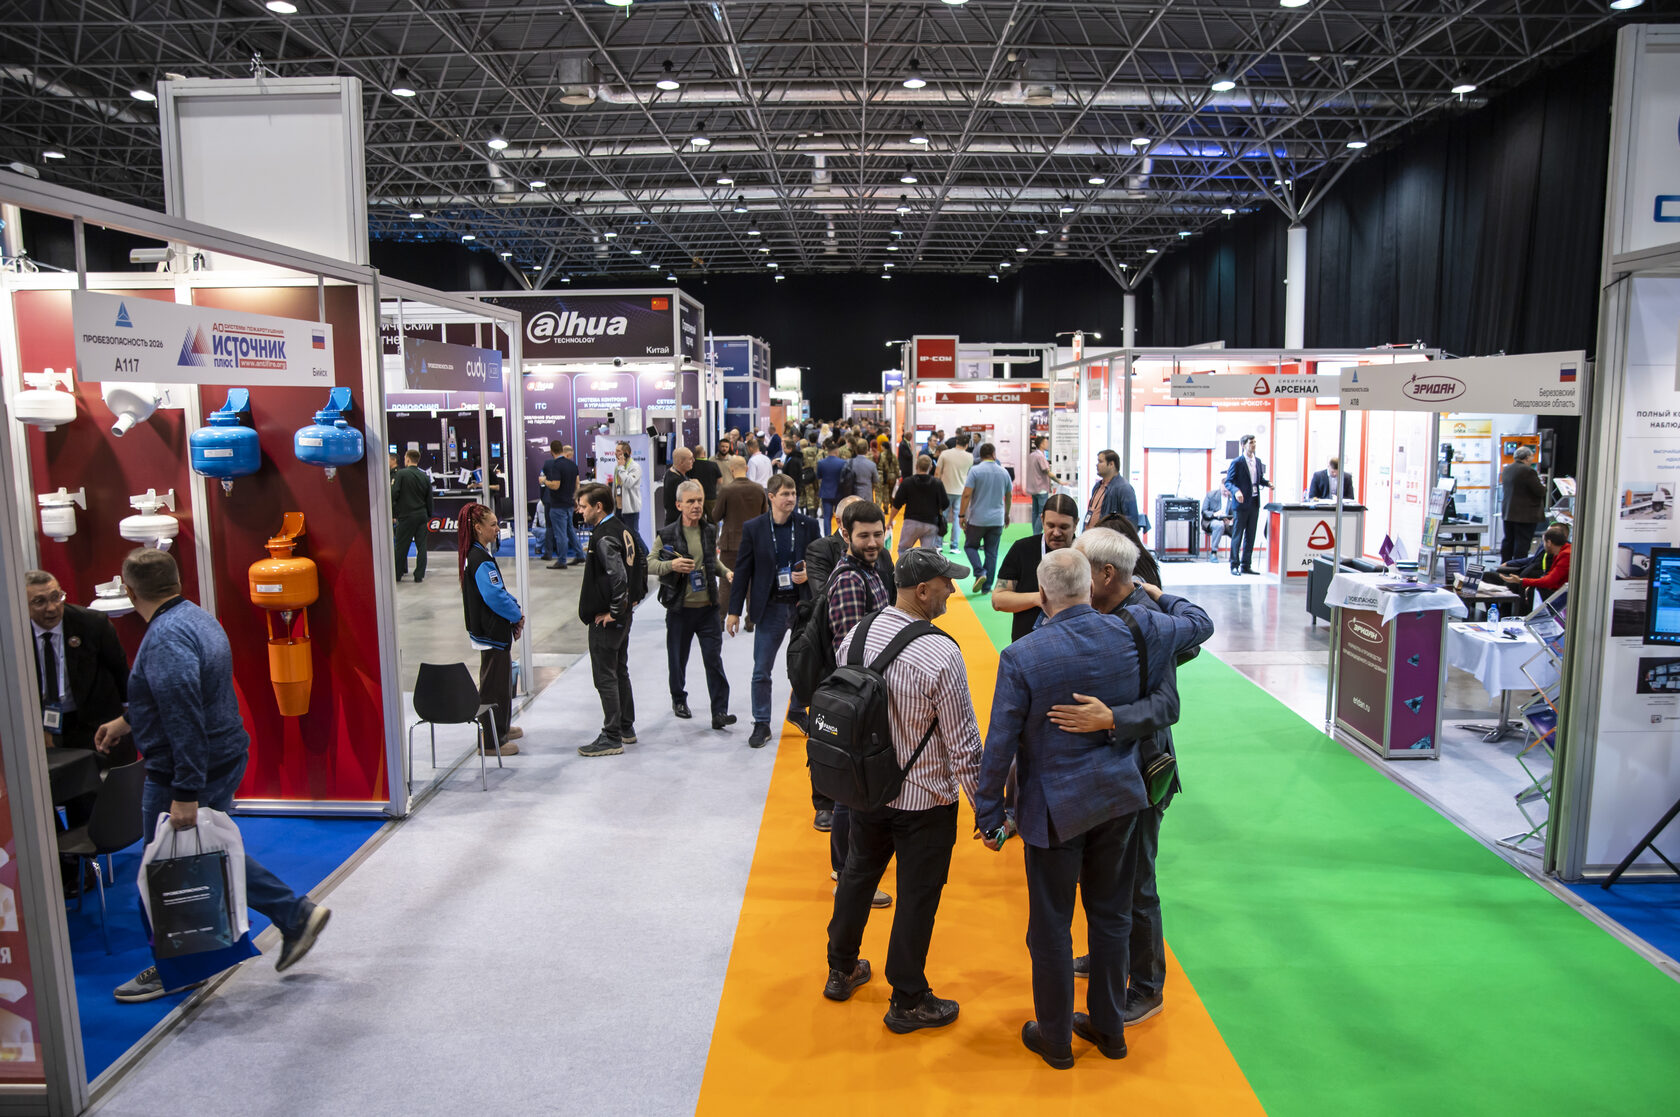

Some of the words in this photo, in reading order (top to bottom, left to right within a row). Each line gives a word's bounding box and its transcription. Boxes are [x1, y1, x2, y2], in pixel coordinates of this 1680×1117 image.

[83, 334, 149, 347] ПРОБЕЗОПАСНОСТЬ
[149, 339, 164, 348] 2026
[212, 334, 287, 368] ИСТОЧНИК
[646, 346, 670, 354] Китай
[114, 357, 140, 373] A117
[213, 358, 234, 368] ПЛЮС
[240, 360, 286, 370] www.antifire.org
[312, 367, 328, 377] Бийск
[466, 356, 486, 383] cudy
[1274, 385, 1319, 393] АРСЕНАЛ
[1413, 383, 1456, 394] ЭРИДАН
[1539, 387, 1576, 397] Березовский
[975, 394, 1020, 402] IP-COM
[1512, 398, 1551, 408] Свердловская
[1552, 398, 1576, 408] область
[1636, 409, 1671, 418] ПОЛНЫЙ
[823, 722, 838, 733] PANDA
